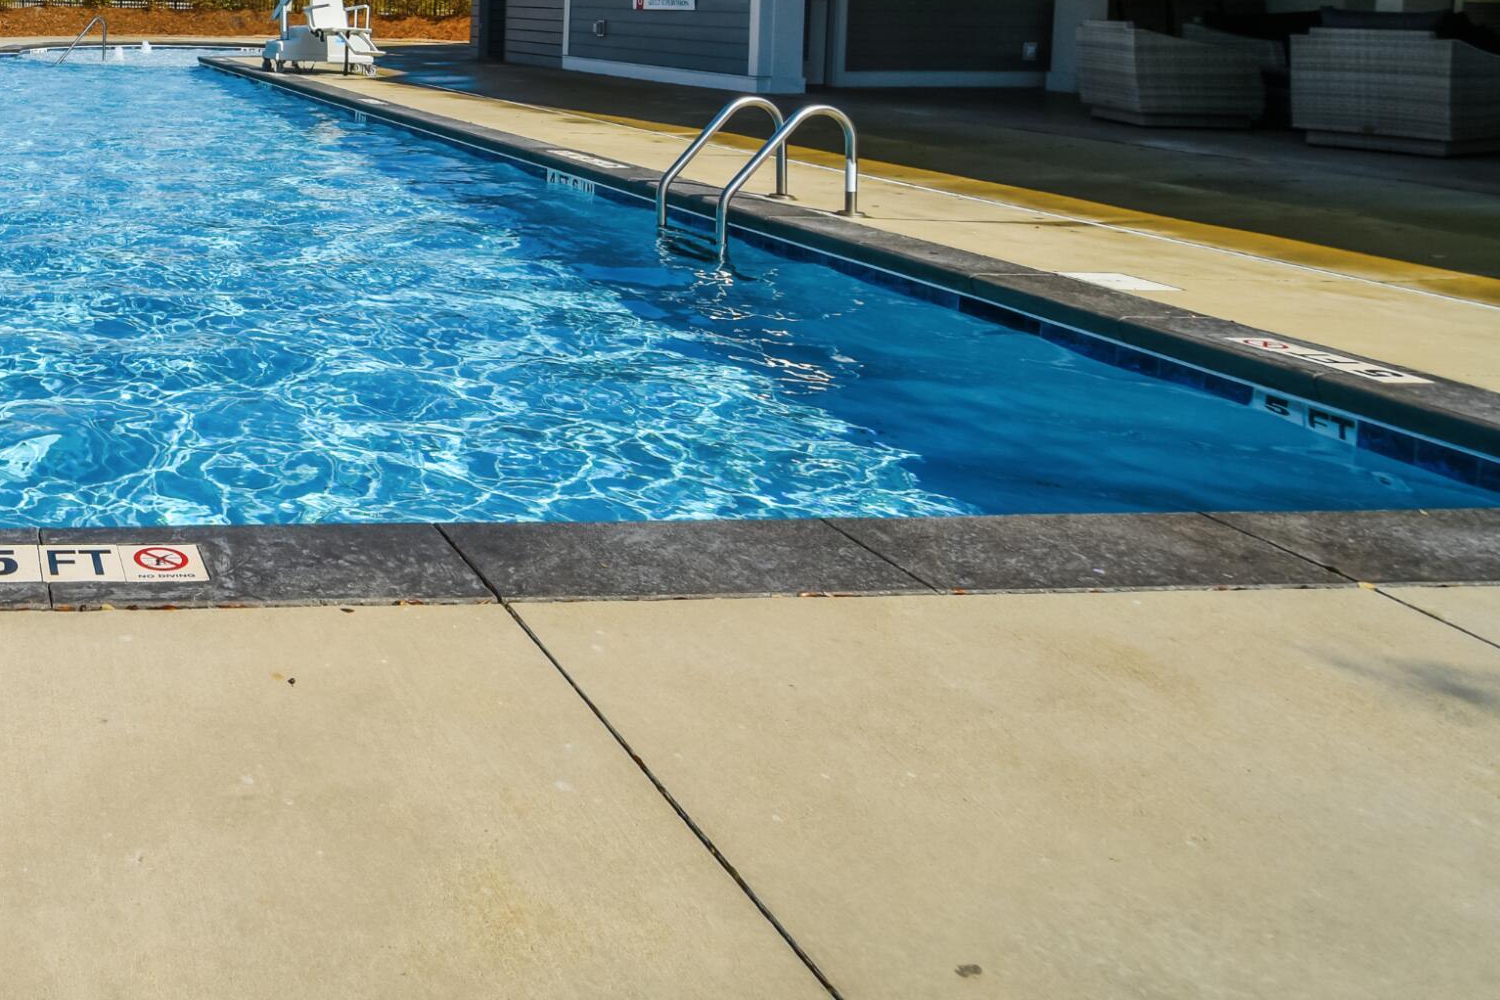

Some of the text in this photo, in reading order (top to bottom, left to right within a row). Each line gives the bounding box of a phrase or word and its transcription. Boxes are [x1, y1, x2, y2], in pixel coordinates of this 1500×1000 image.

[1264, 394, 1355, 441] 5 FT
[46, 549, 111, 576] FT
